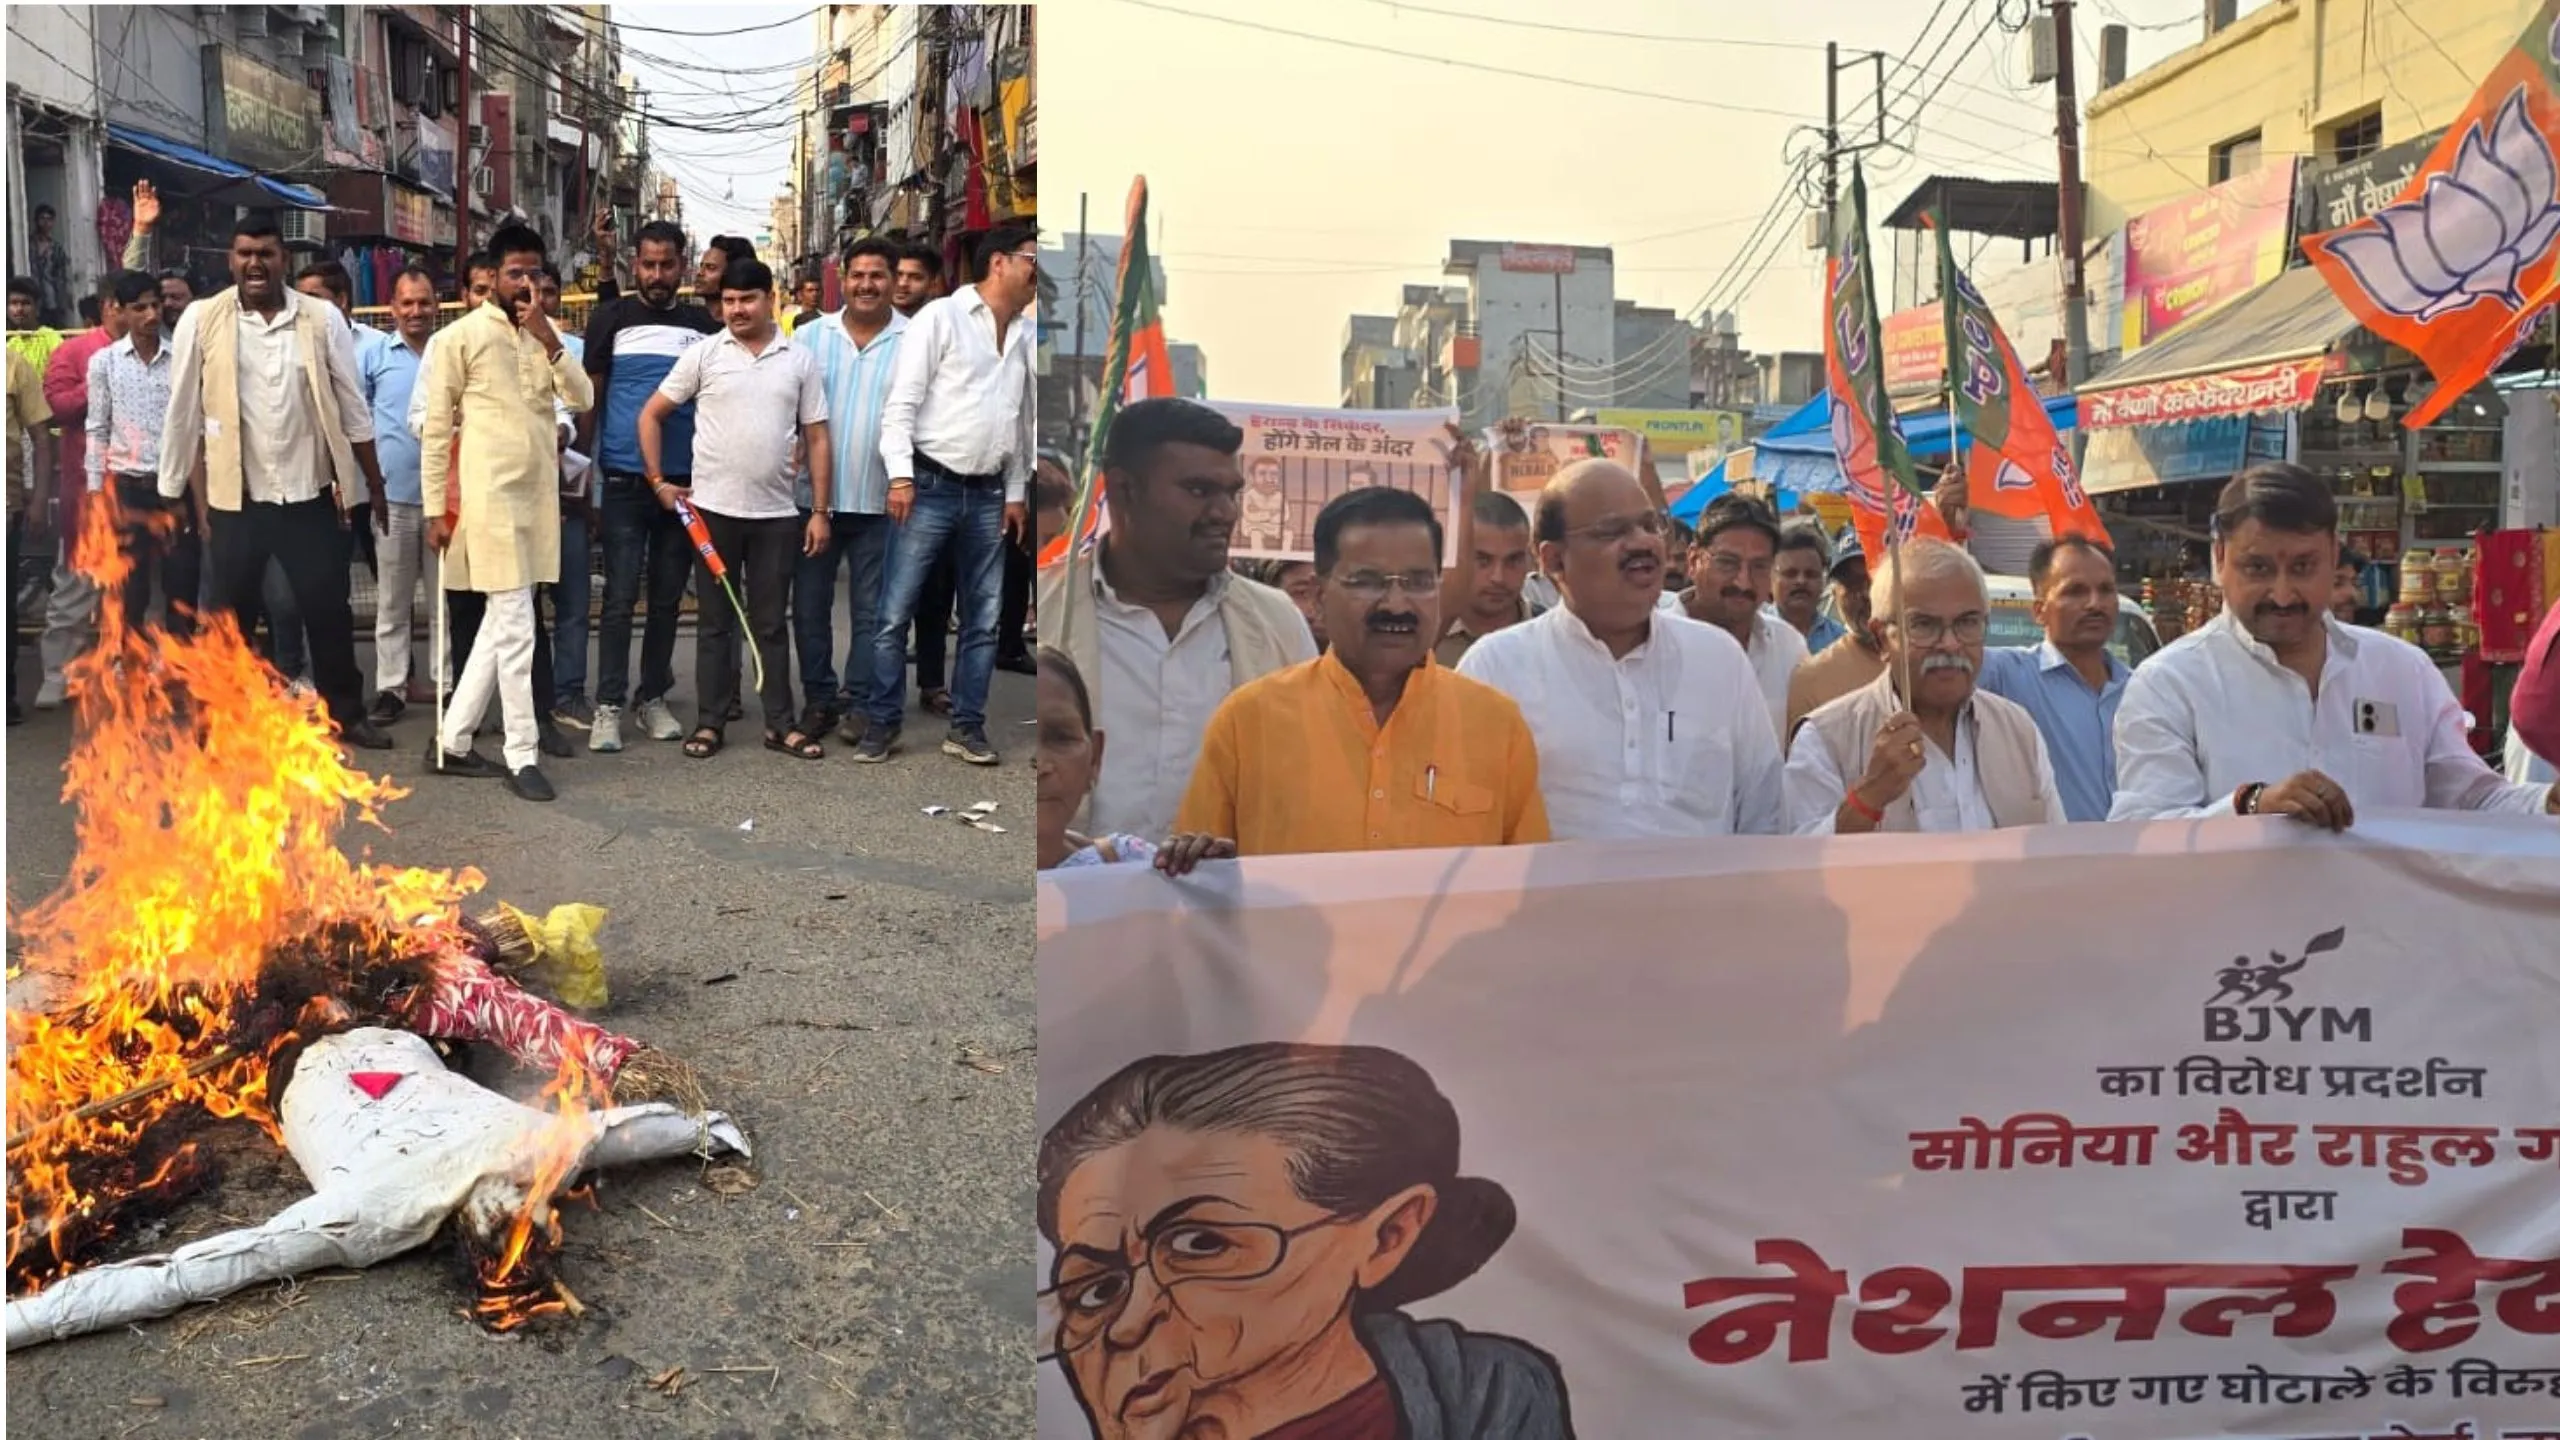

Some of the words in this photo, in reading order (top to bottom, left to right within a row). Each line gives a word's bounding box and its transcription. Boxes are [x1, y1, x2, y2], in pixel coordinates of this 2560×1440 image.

[1263, 427, 1300, 452] होंगे
[1303, 429, 1341, 453] जेल
[1346, 431, 1366, 454] के
[1371, 434, 1415, 457] अंदर
[2204, 1007, 2372, 1042] BJYM
[2097, 1066, 2165, 1098] का
[2174, 1055, 2311, 1097] विरोध
[2320, 1057, 2487, 1099] प्रदर्शन
[1908, 1112, 2160, 1172] सोनिया
[2176, 1097, 2298, 1166] और
[2312, 1124, 2500, 1187] राहुल
[2241, 1190, 2338, 1231] द्वारा
[1683, 1238, 2359, 1364] नेशनल
[1961, 1373, 2011, 1414] में
[2017, 1369, 2120, 1412] किए
[2129, 1374, 2209, 1405] गए
[2217, 1365, 2376, 1404] घोटाले
[2384, 1365, 2437, 1398] के
